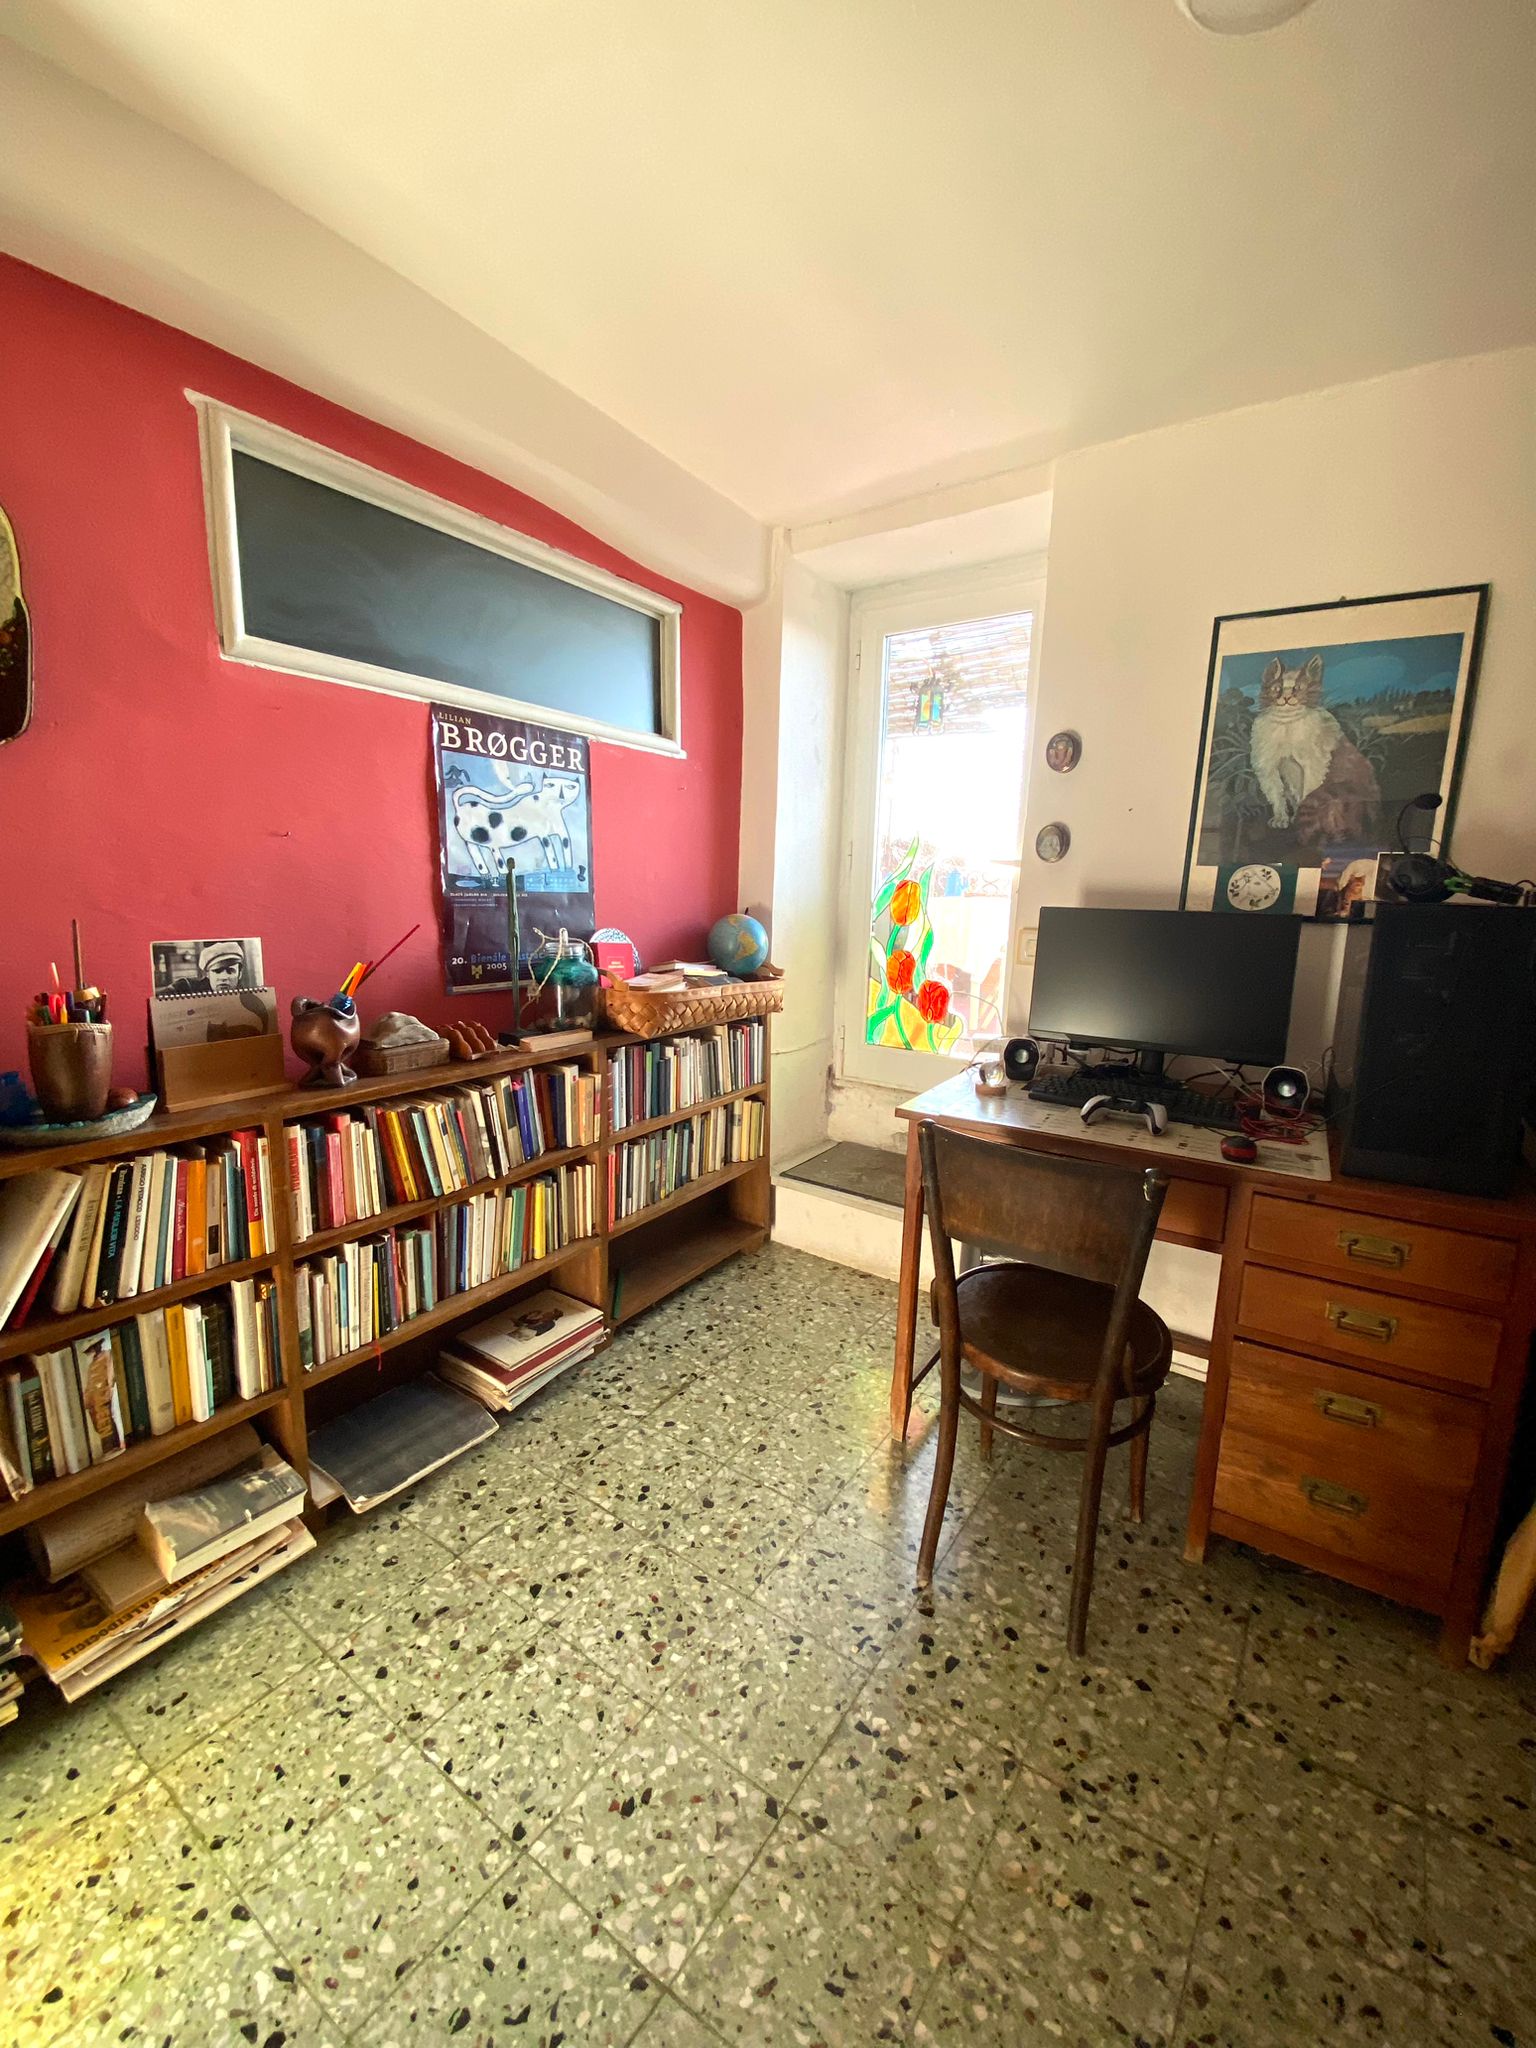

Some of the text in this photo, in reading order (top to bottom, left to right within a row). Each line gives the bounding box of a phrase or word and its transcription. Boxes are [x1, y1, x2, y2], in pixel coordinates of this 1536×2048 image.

[438, 712, 472, 725] LILIAN
[440, 722, 585, 771] BRØGGER
[451, 957, 468, 965] 20.
[486, 963, 507, 971] 2005
